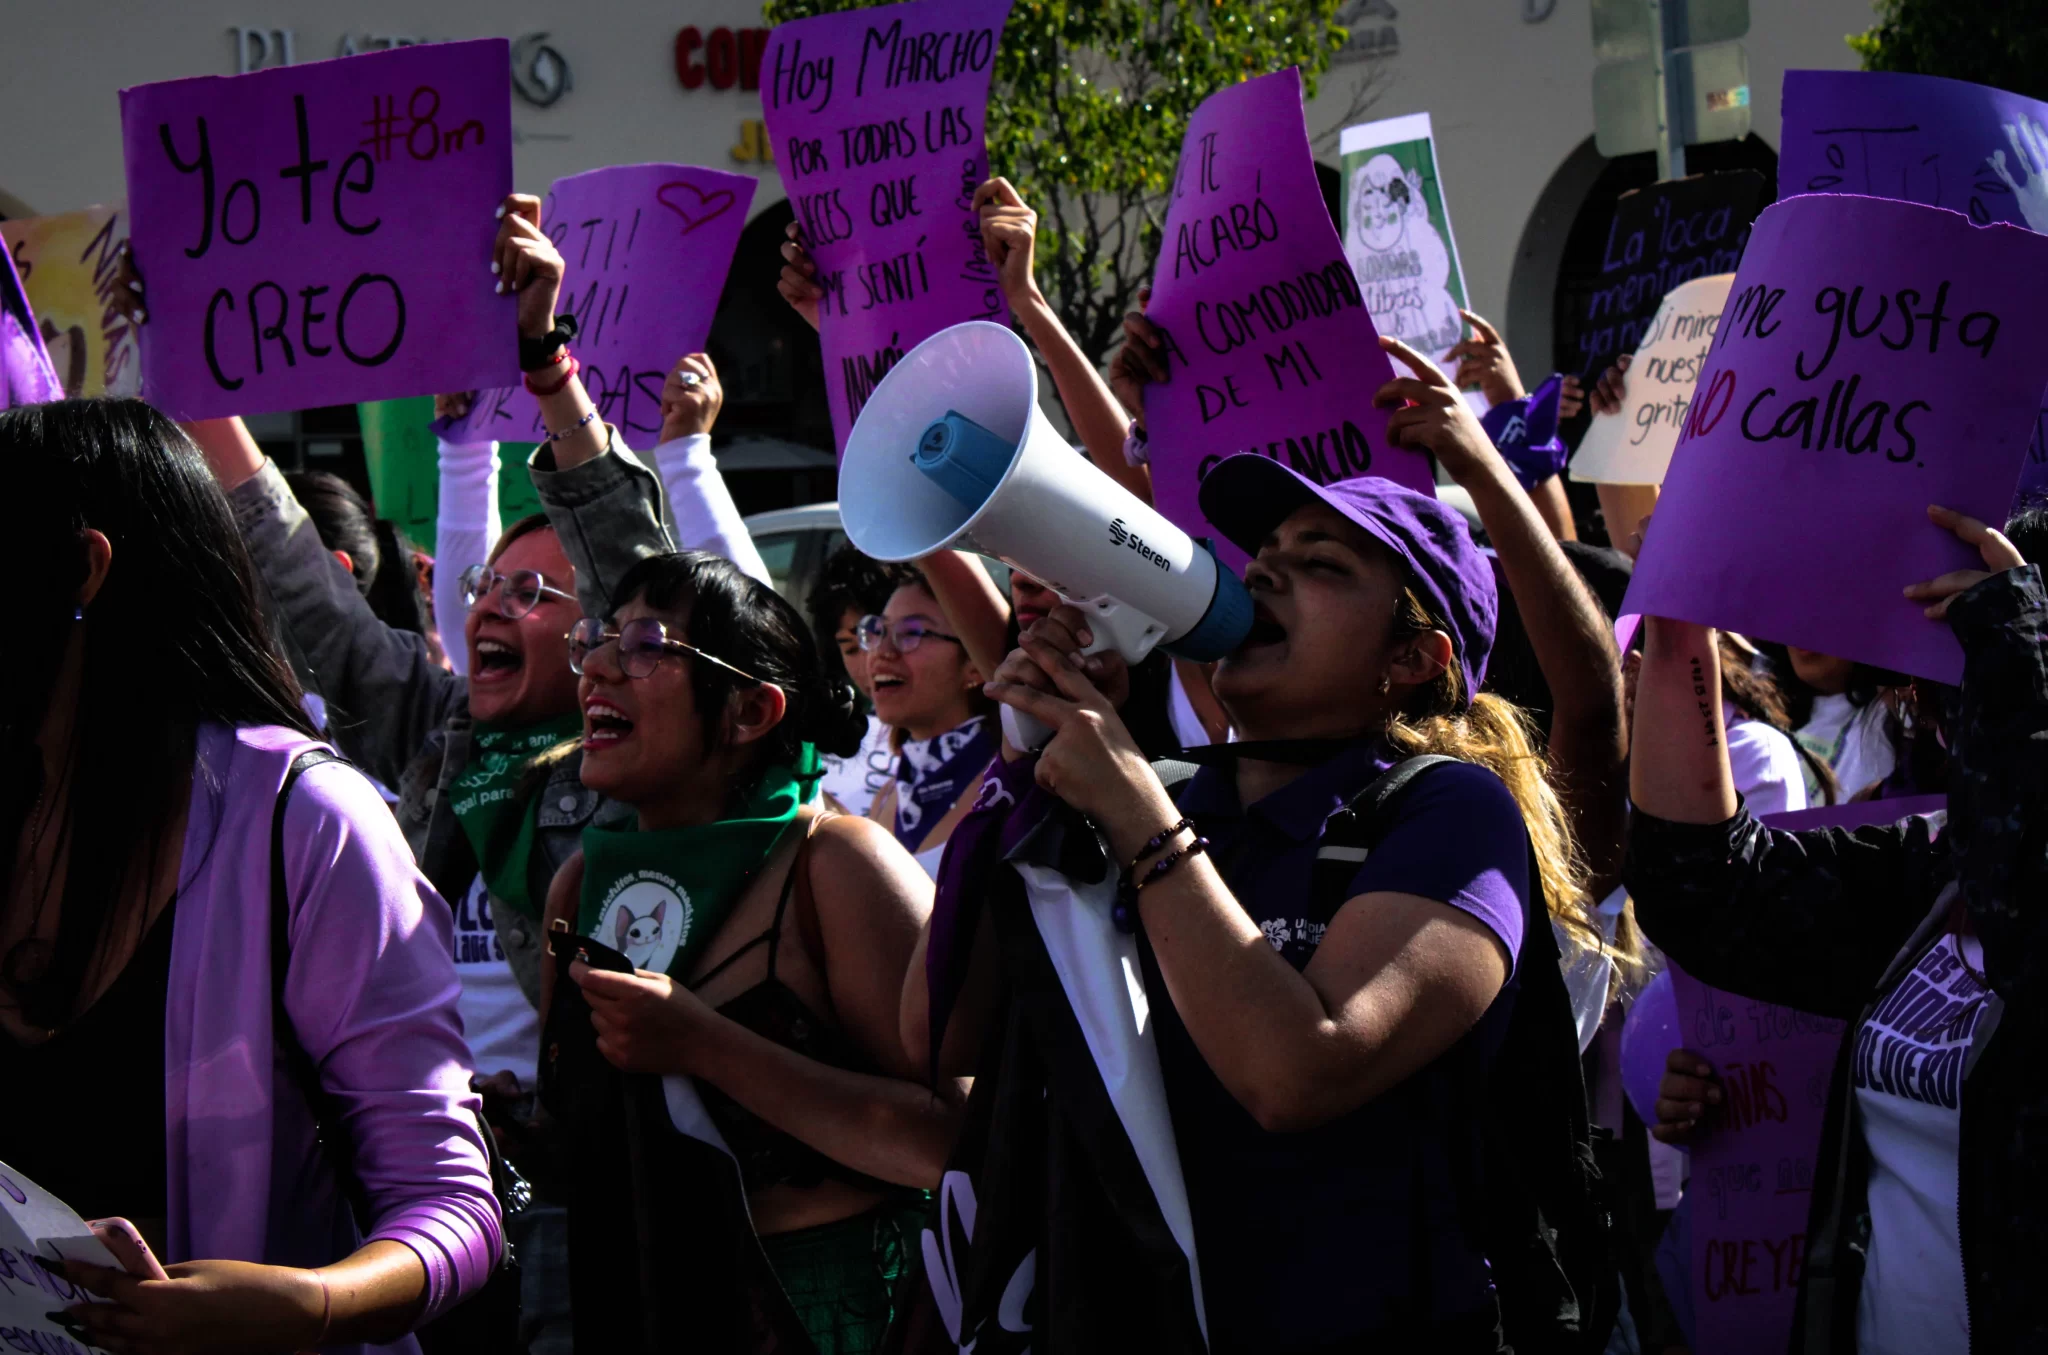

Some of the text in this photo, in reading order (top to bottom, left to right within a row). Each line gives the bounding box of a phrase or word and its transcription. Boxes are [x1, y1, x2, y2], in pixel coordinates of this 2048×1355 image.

[772, 19, 993, 114] Hoy MARCHO
[358, 85, 485, 162] #8m
[789, 107, 973, 180] POR TODAS LAS
[1199, 131, 1222, 194] TE
[159, 116, 261, 258] Yo
[280, 94, 381, 234] te
[870, 174, 922, 227] QUE
[1175, 169, 1278, 279] ACABÓ
[1602, 212, 1646, 274] La
[822, 235, 929, 316] ME SENTÍ
[1196, 260, 1362, 354] COMODIDAD
[204, 273, 406, 390] CREO
[1795, 281, 2000, 381] gusta
[1195, 340, 1323, 423] DE MI
[1741, 374, 1932, 468] callas.
[1127, 533, 1171, 572] Steren
[1704, 1234, 1807, 1302] CREYE
